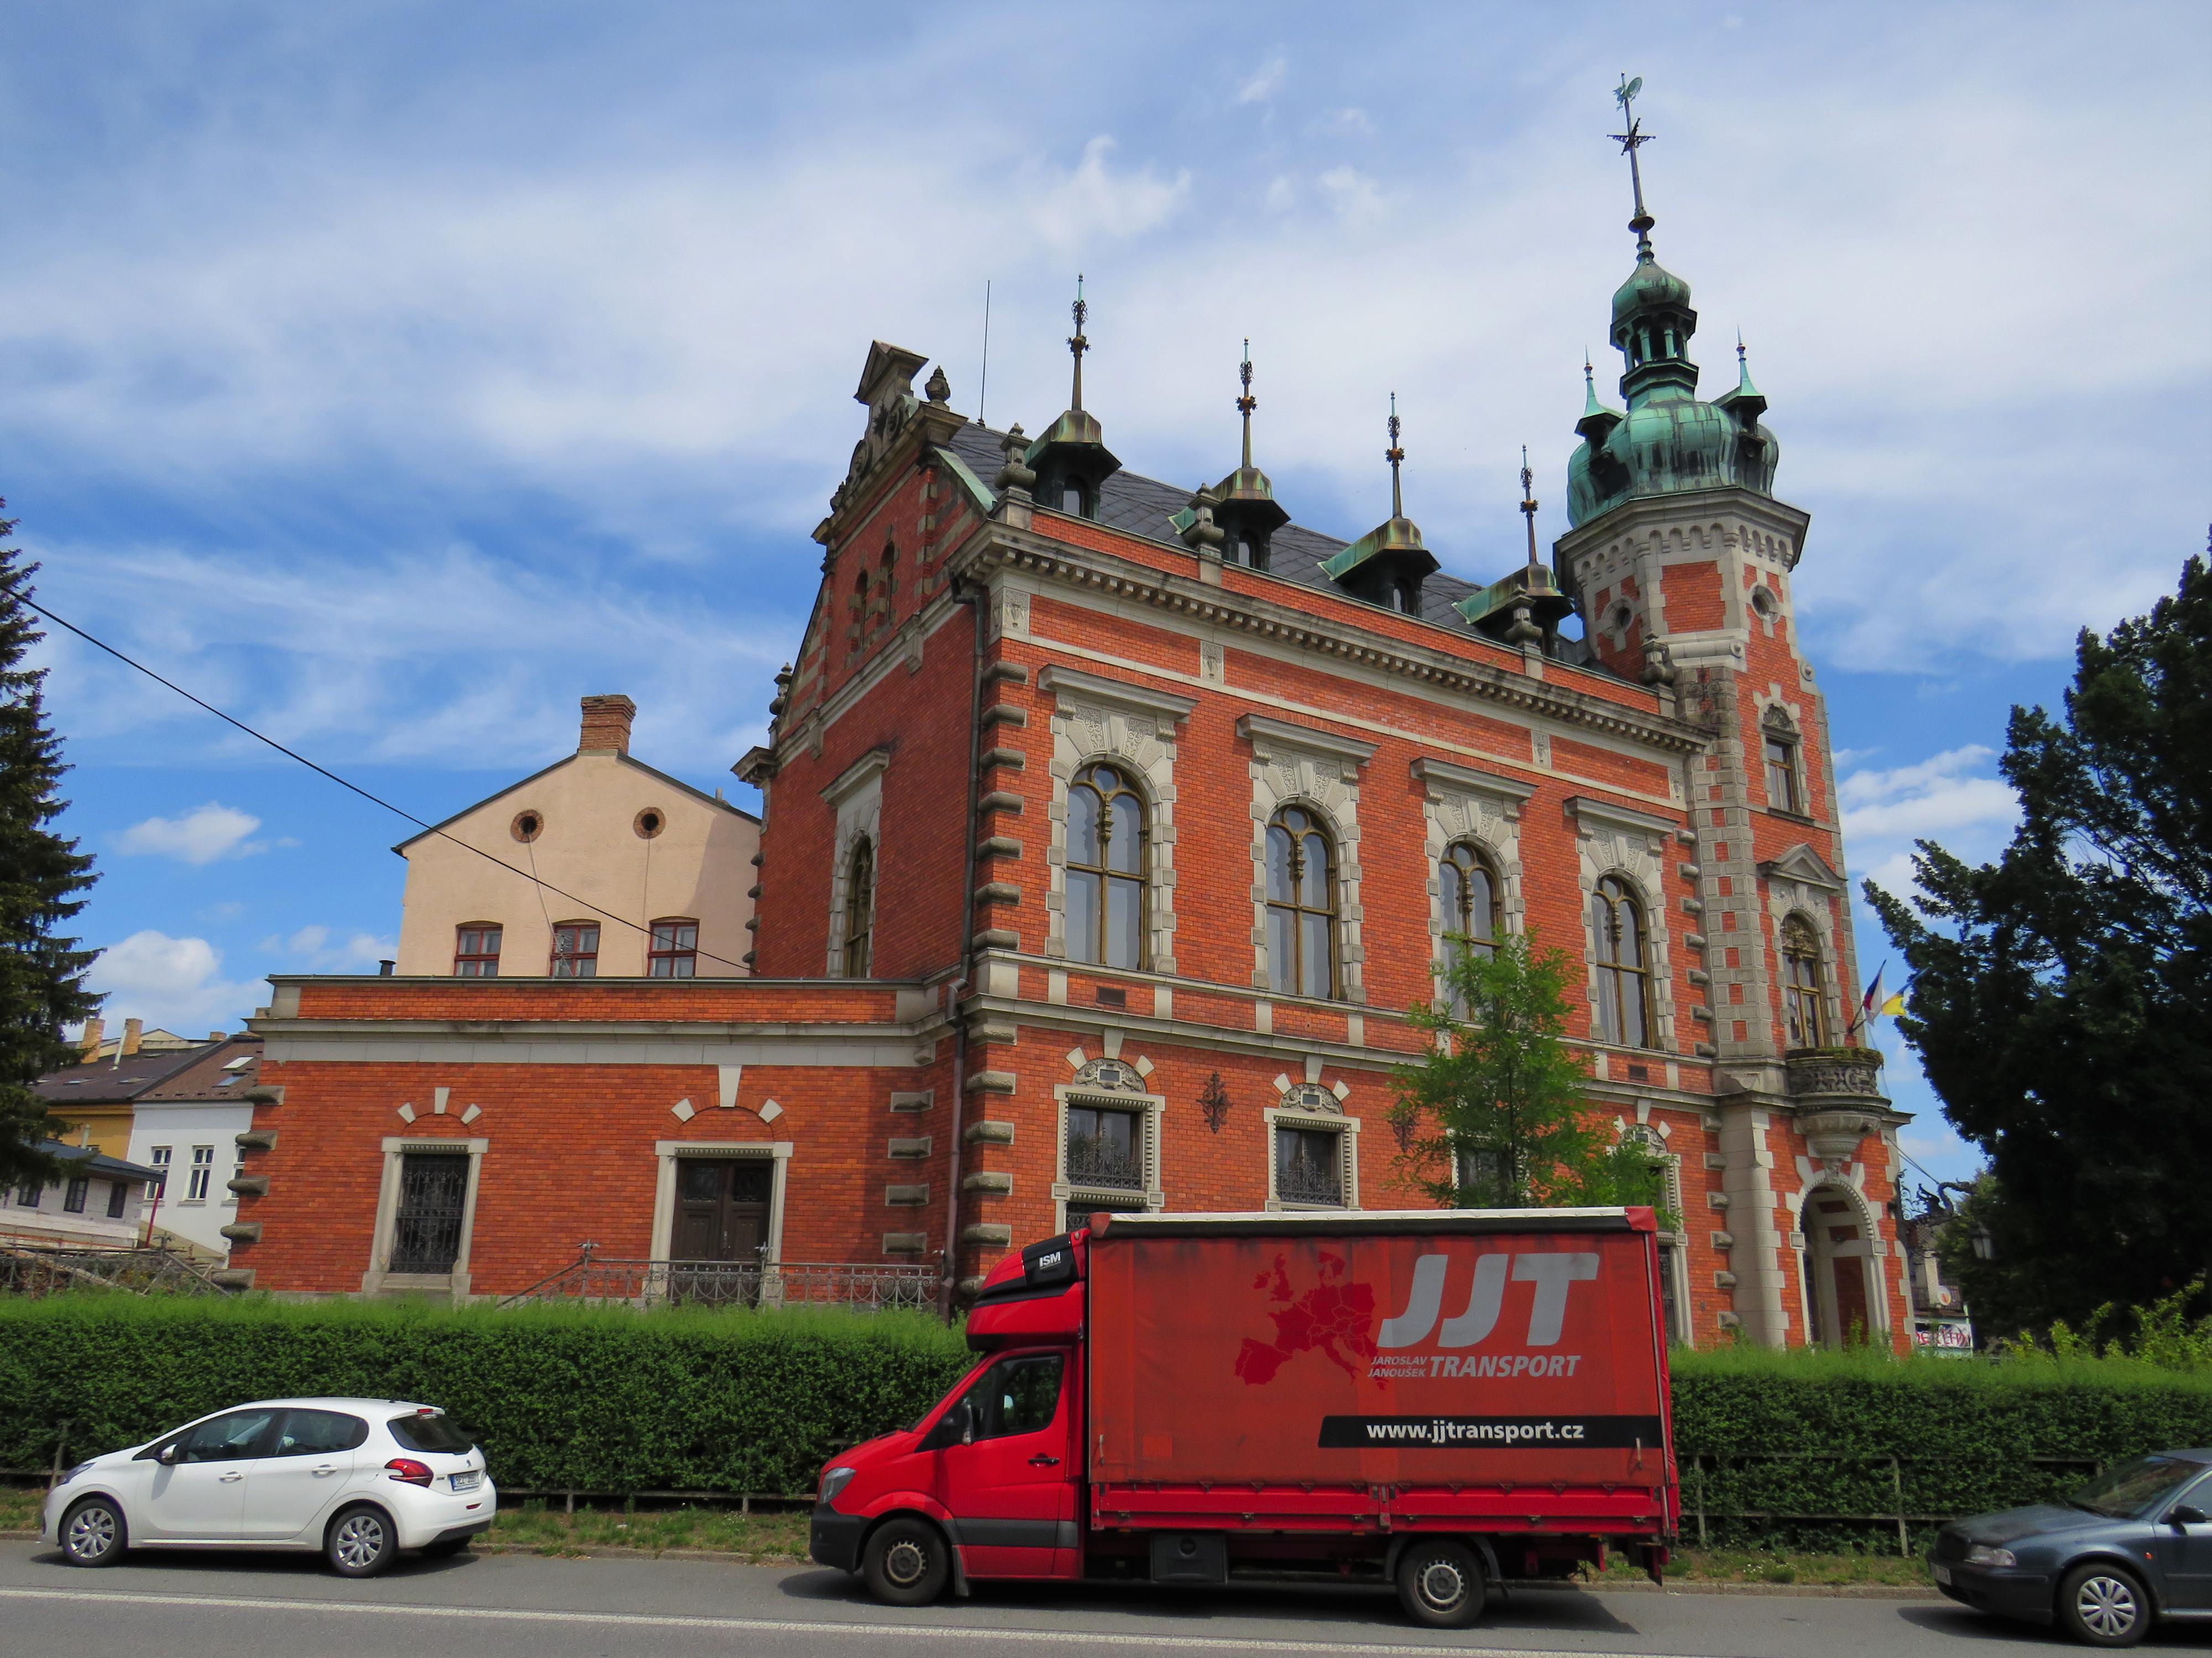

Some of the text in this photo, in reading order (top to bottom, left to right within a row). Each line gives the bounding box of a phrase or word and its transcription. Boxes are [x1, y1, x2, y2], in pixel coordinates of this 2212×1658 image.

[1039, 1251, 1061, 1267] ISM
[1376, 1252, 1600, 1348] JJT
[1370, 1356, 1428, 1366] JAROSLAV
[1430, 1356, 1581, 1378] TRANSPORT
[1367, 1367, 1426, 1378] JANOUŠEK
[1366, 1420, 1584, 1443] www.jjtransport.cz
